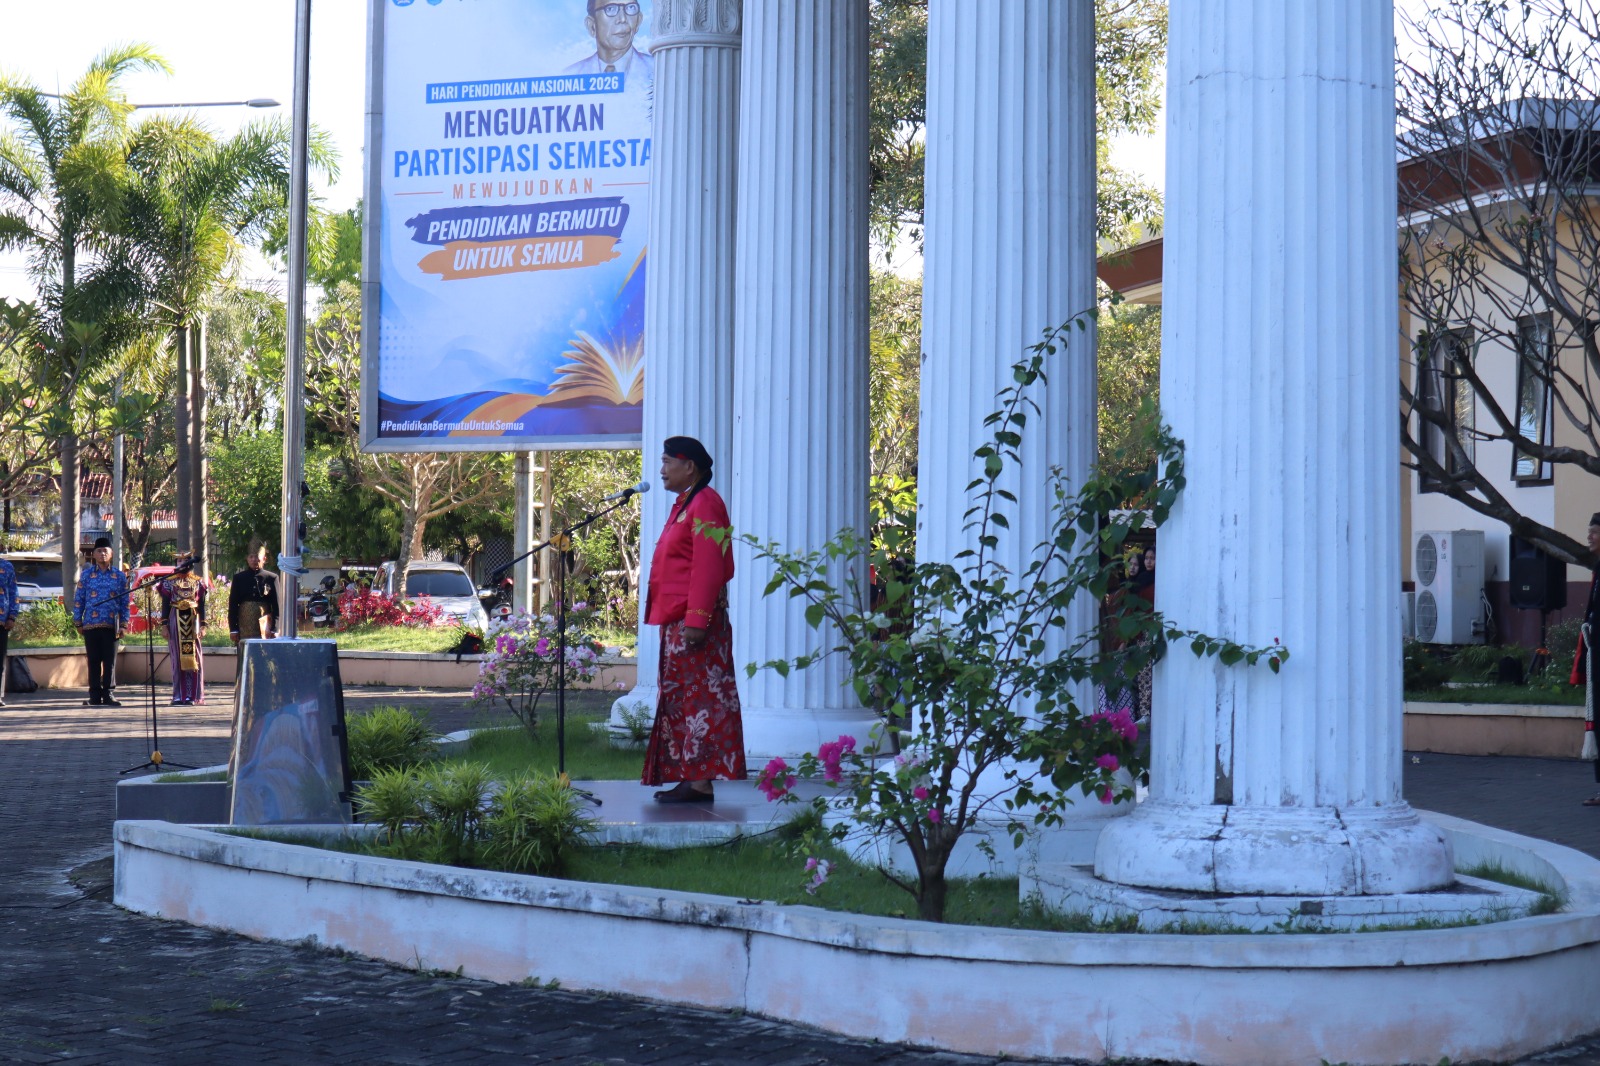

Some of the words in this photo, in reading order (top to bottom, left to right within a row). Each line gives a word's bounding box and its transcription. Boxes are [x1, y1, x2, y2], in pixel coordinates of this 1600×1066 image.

[431, 86, 458, 100] HARI
[461, 82, 527, 98] PENDIDIKAN
[530, 78, 586, 95] NASIONAL
[589, 76, 619, 91] 2026
[444, 103, 604, 139] MENGUATKAN
[394, 143, 539, 178] PARTISIPASI
[548, 138, 651, 171] SEMESTA
[452, 177, 593, 200] MEWUJUDKAN
[427, 213, 532, 242] PENDIDIKAN
[535, 206, 622, 234] BERMUTU
[453, 246, 514, 271] UNTUK
[520, 240, 583, 267] SEMUA
[380, 420, 524, 432] #PendidikanBermutuUntukSemua
